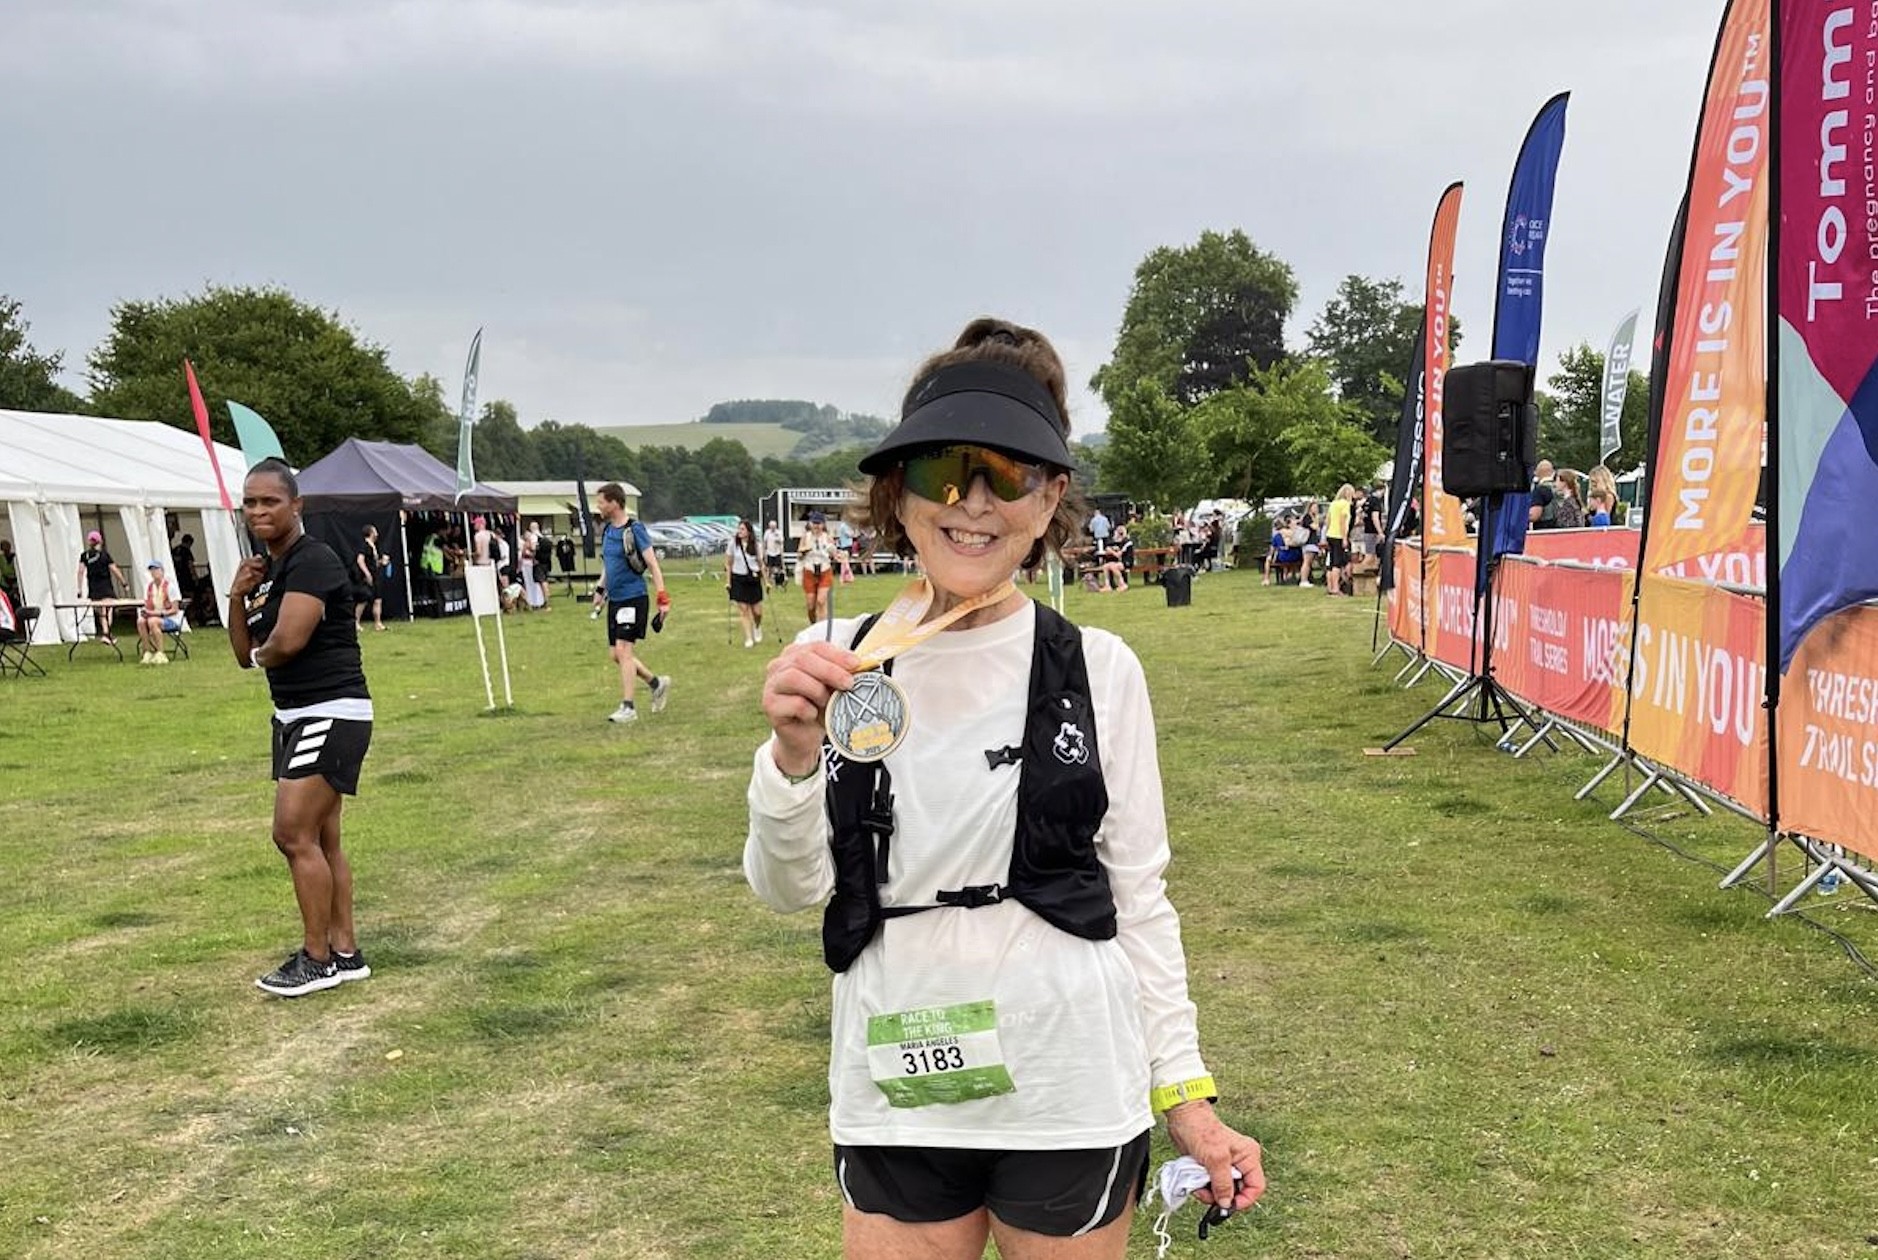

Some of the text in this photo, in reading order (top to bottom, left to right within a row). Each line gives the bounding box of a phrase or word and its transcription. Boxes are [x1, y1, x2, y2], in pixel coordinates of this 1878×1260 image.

[1865, 50, 1876, 105] and
[1807, 0, 1854, 323] Tomm
[1863, 114, 1878, 261] pregnancy
[1706, 221, 1746, 283] IN
[1865, 269, 1878, 321] The
[1696, 301, 1733, 353] IS
[1432, 368, 1444, 401] IN
[1604, 343, 1630, 429] WATER
[1673, 368, 1724, 531] MORE
[1653, 629, 1688, 716] IN
[1799, 723, 1878, 789] TRAIL S
[900, 1009, 945, 1026] RACE TO
[900, 1036, 958, 1050] MARIA ANGELES
[903, 1021, 952, 1040] THE KING
[902, 1046, 964, 1074] 3183
